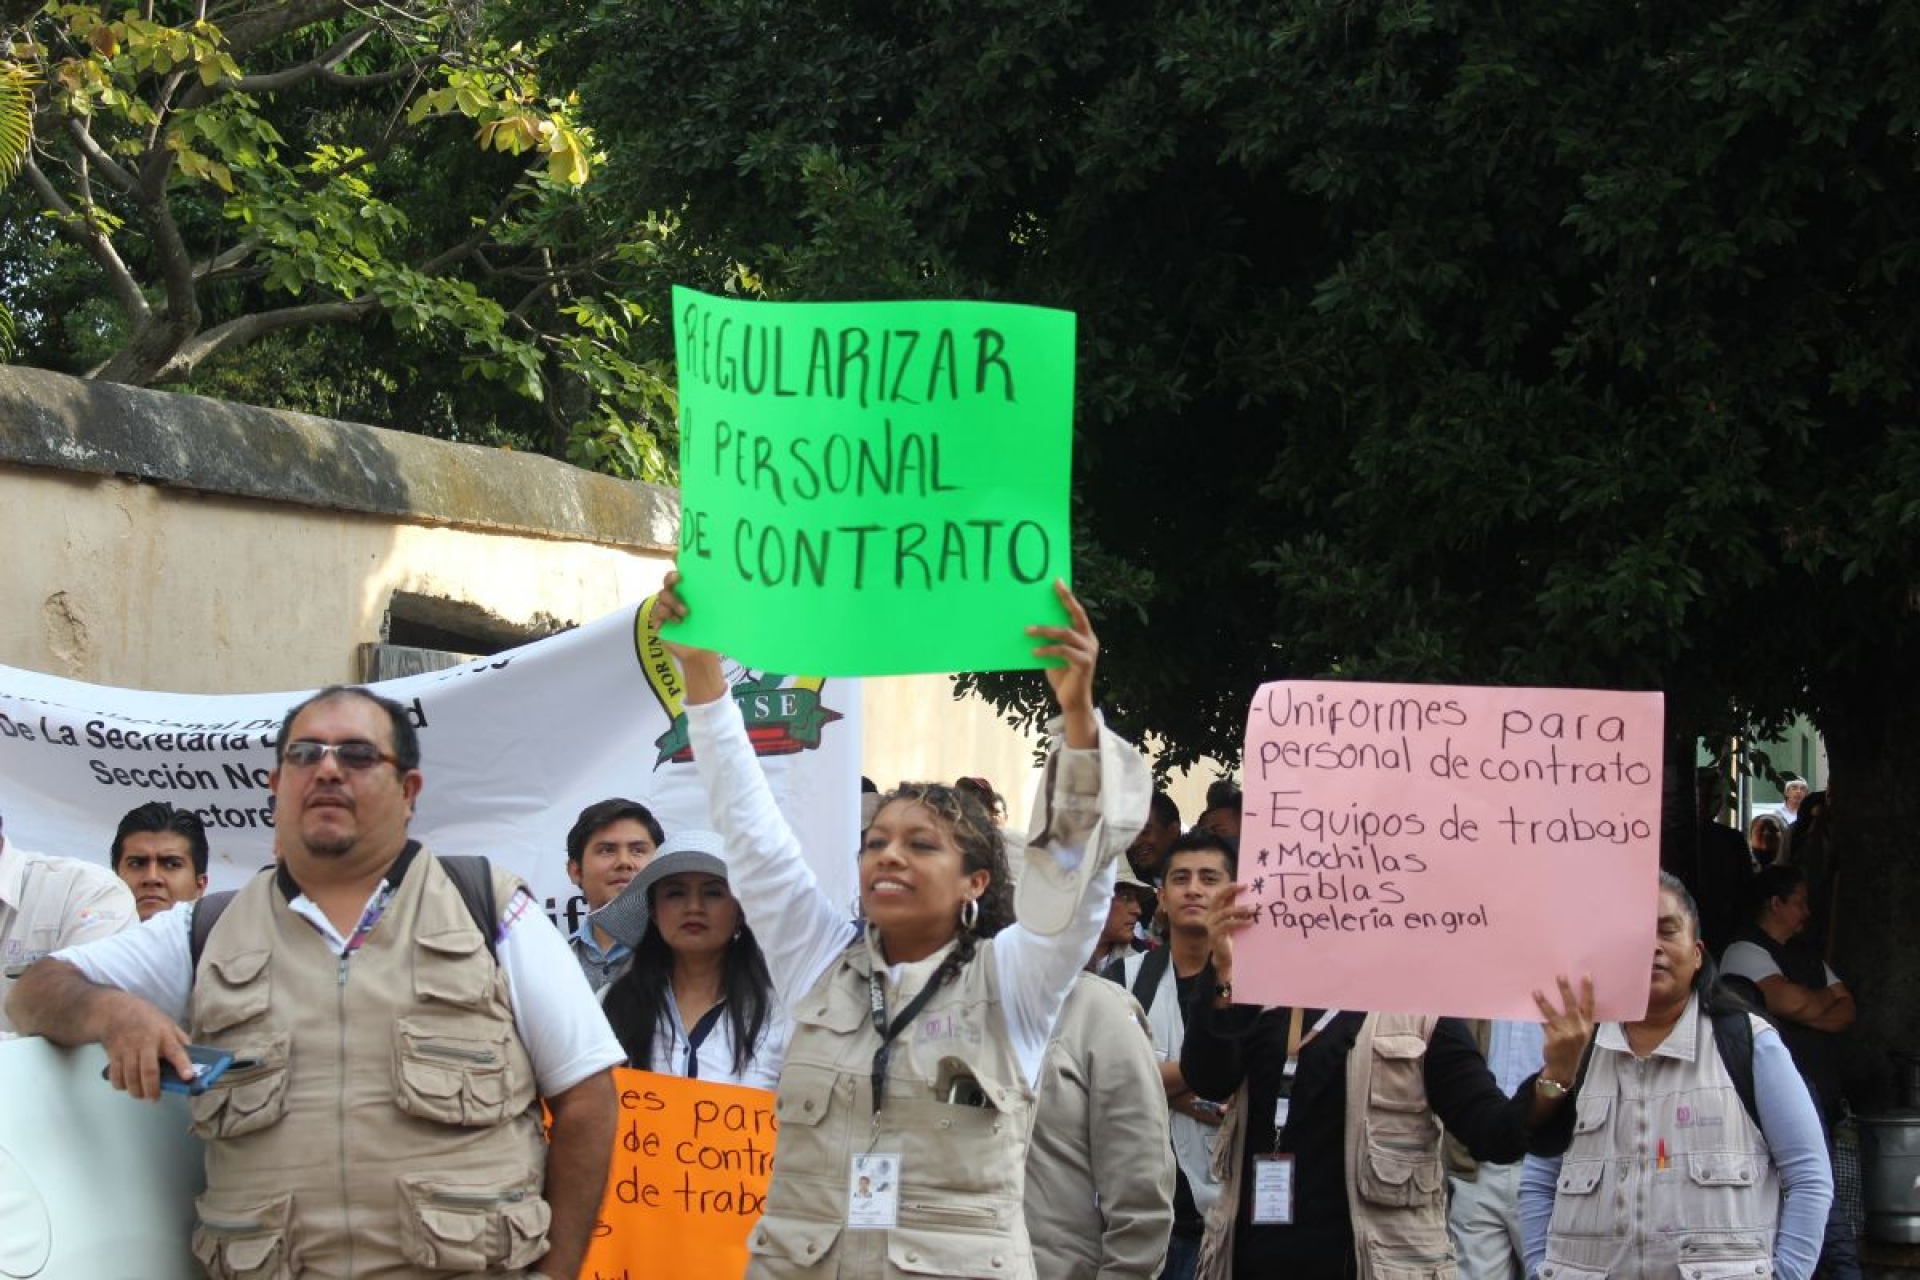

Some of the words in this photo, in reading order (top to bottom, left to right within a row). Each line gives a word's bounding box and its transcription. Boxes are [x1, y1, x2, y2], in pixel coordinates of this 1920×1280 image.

[683, 303, 1017, 408] REGULARIZAR
[683, 407, 691, 466] A
[715, 418, 964, 506] PERSONAL
[682, 507, 711, 558] DE
[735, 517, 1050, 590] CONTRATO
[655, 660, 681, 698] POR
[0, 713, 35, 741] De
[40, 716, 80, 746] La
[1501, 710, 1626, 749] para
[89, 759, 219, 789] Sección
[1260, 736, 1411, 779] personal
[1430, 737, 1470, 780] de
[1480, 744, 1652, 786] contrato
[1270, 791, 1425, 846] Equipos
[1440, 803, 1479, 841] de
[1498, 805, 1651, 845] trabajo
[1278, 842, 1428, 875] Mochilas
[1269, 871, 1405, 903] Tablas
[623, 1119, 660, 1157] de
[676, 1138, 775, 1177] contr
[616, 1165, 660, 1207] de
